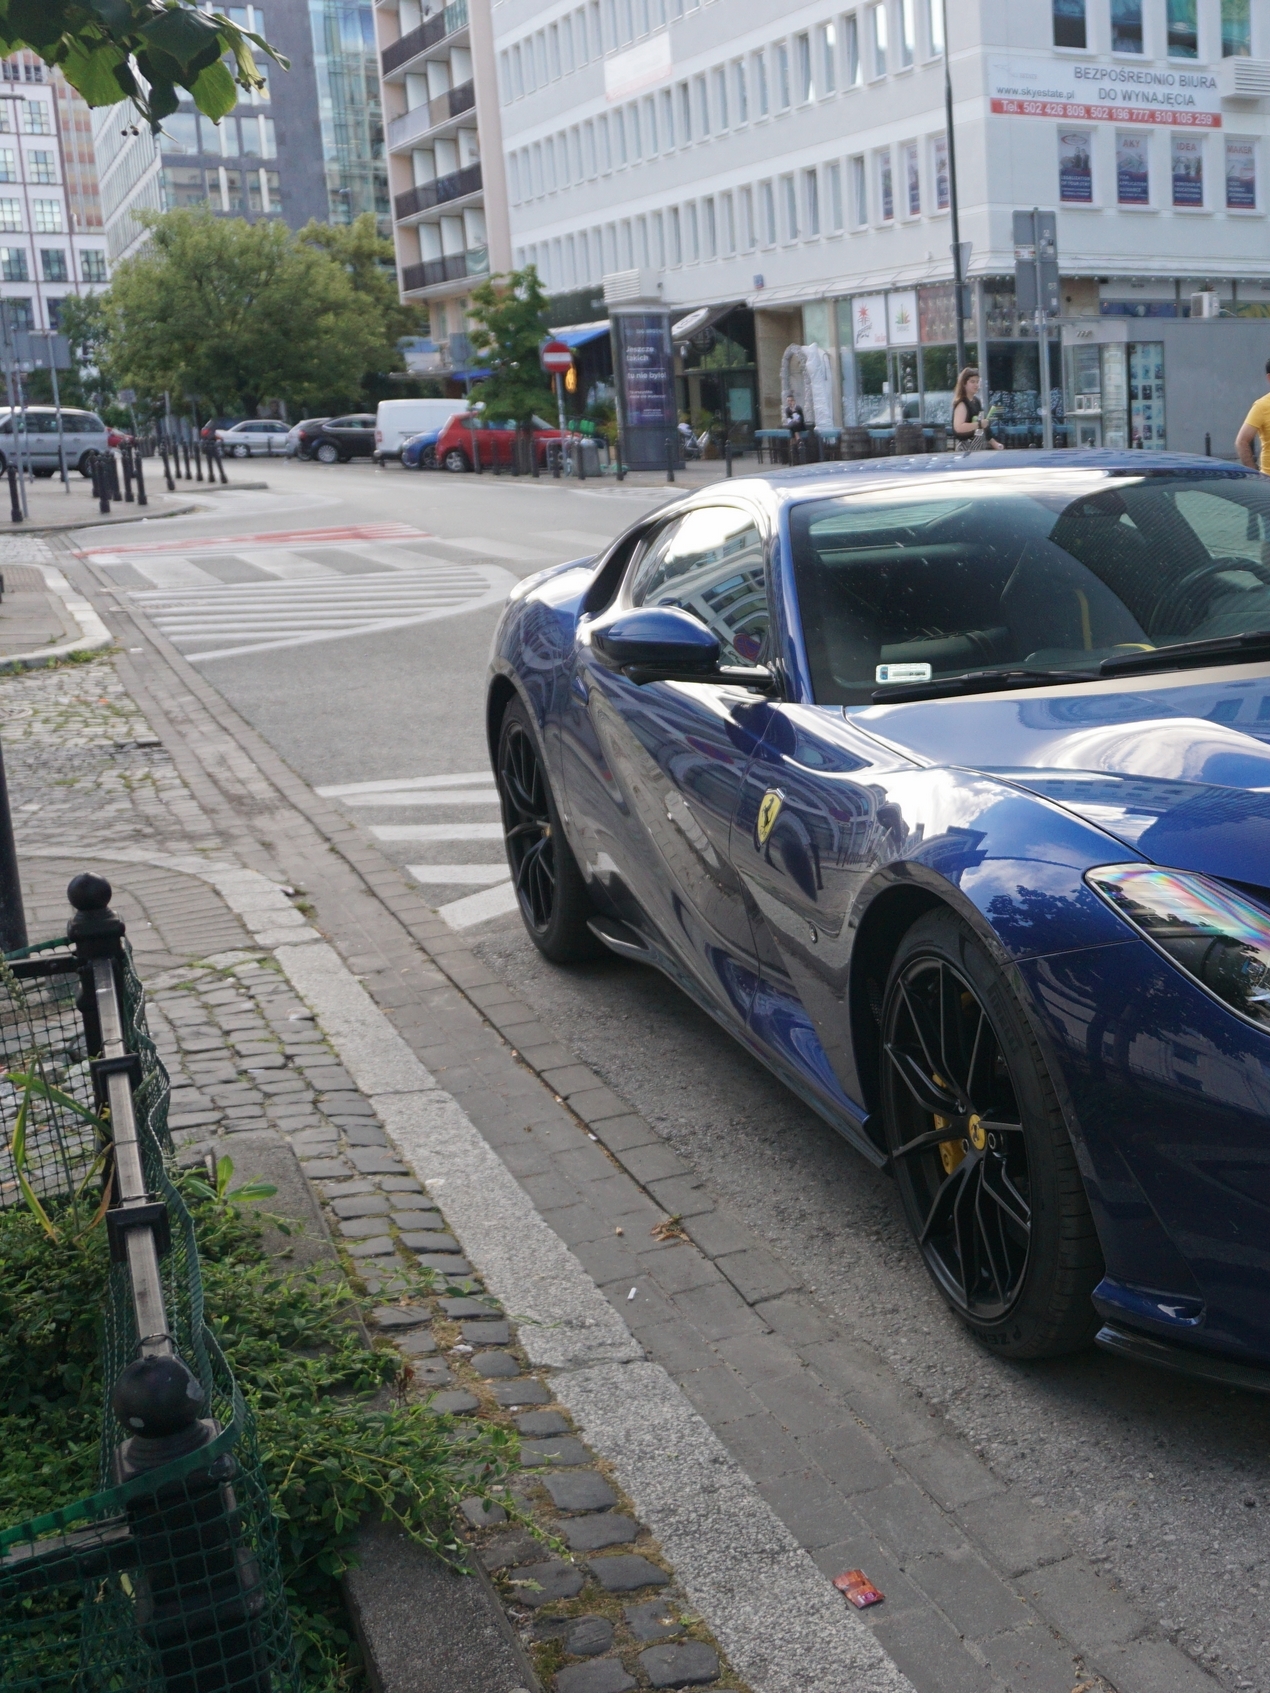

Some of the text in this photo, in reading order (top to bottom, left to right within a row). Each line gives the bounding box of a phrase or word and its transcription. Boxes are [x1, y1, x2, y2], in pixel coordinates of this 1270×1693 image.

[1074, 66, 1217, 89] BEZPOŚREDNIO BIURA
[996, 86, 1075, 100] www.skyestate.pl
[1098, 87, 1196, 107] DO WYNAJĘCIA
[1002, 100, 1213, 124] Tel. 502 426 809, 502 196 777, 510 105 259
[1122, 139, 1140, 148] AKY
[1176, 142, 1197, 151] IDEA
[1227, 145, 1253, 154] MAKER
